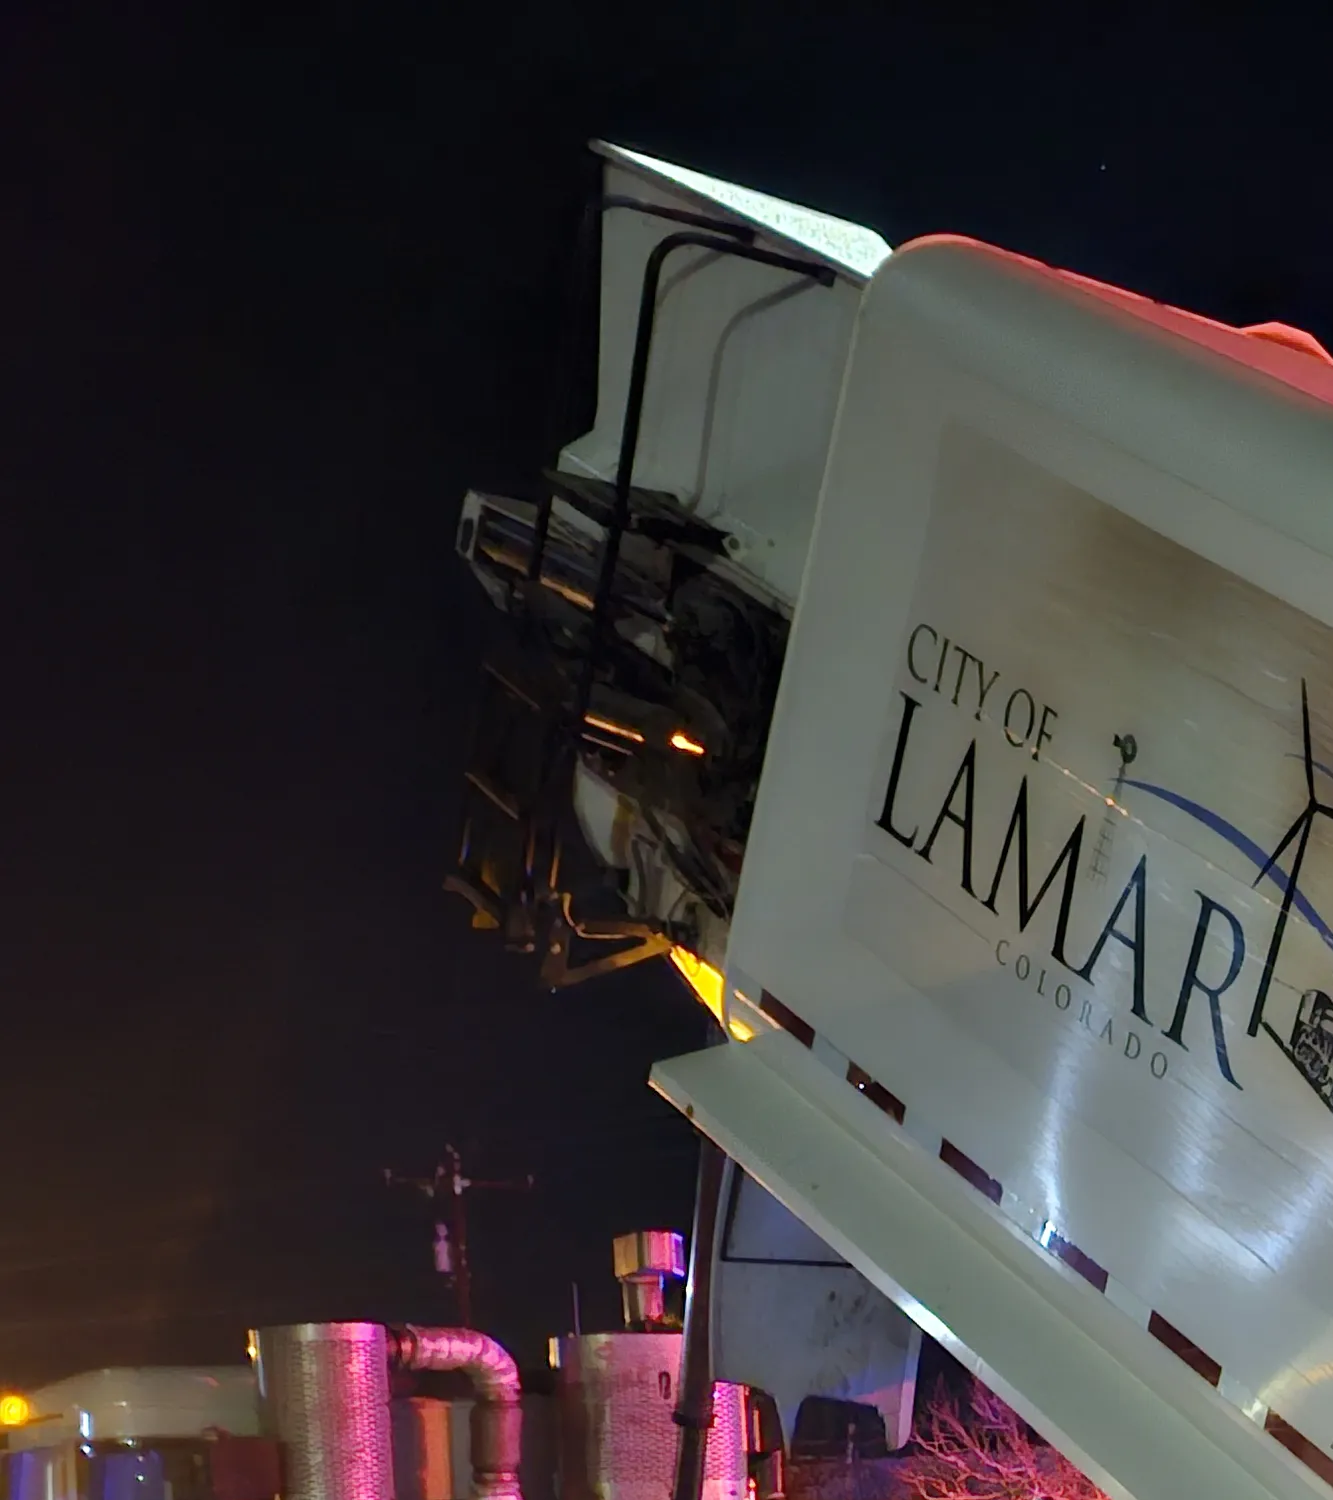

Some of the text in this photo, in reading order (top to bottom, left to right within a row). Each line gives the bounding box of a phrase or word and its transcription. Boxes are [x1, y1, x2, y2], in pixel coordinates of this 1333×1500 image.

[907, 623, 1058, 762] CITY OF
[874, 690, 1243, 1091] LAMAR
[995, 939, 1168, 1079] COLORADO
